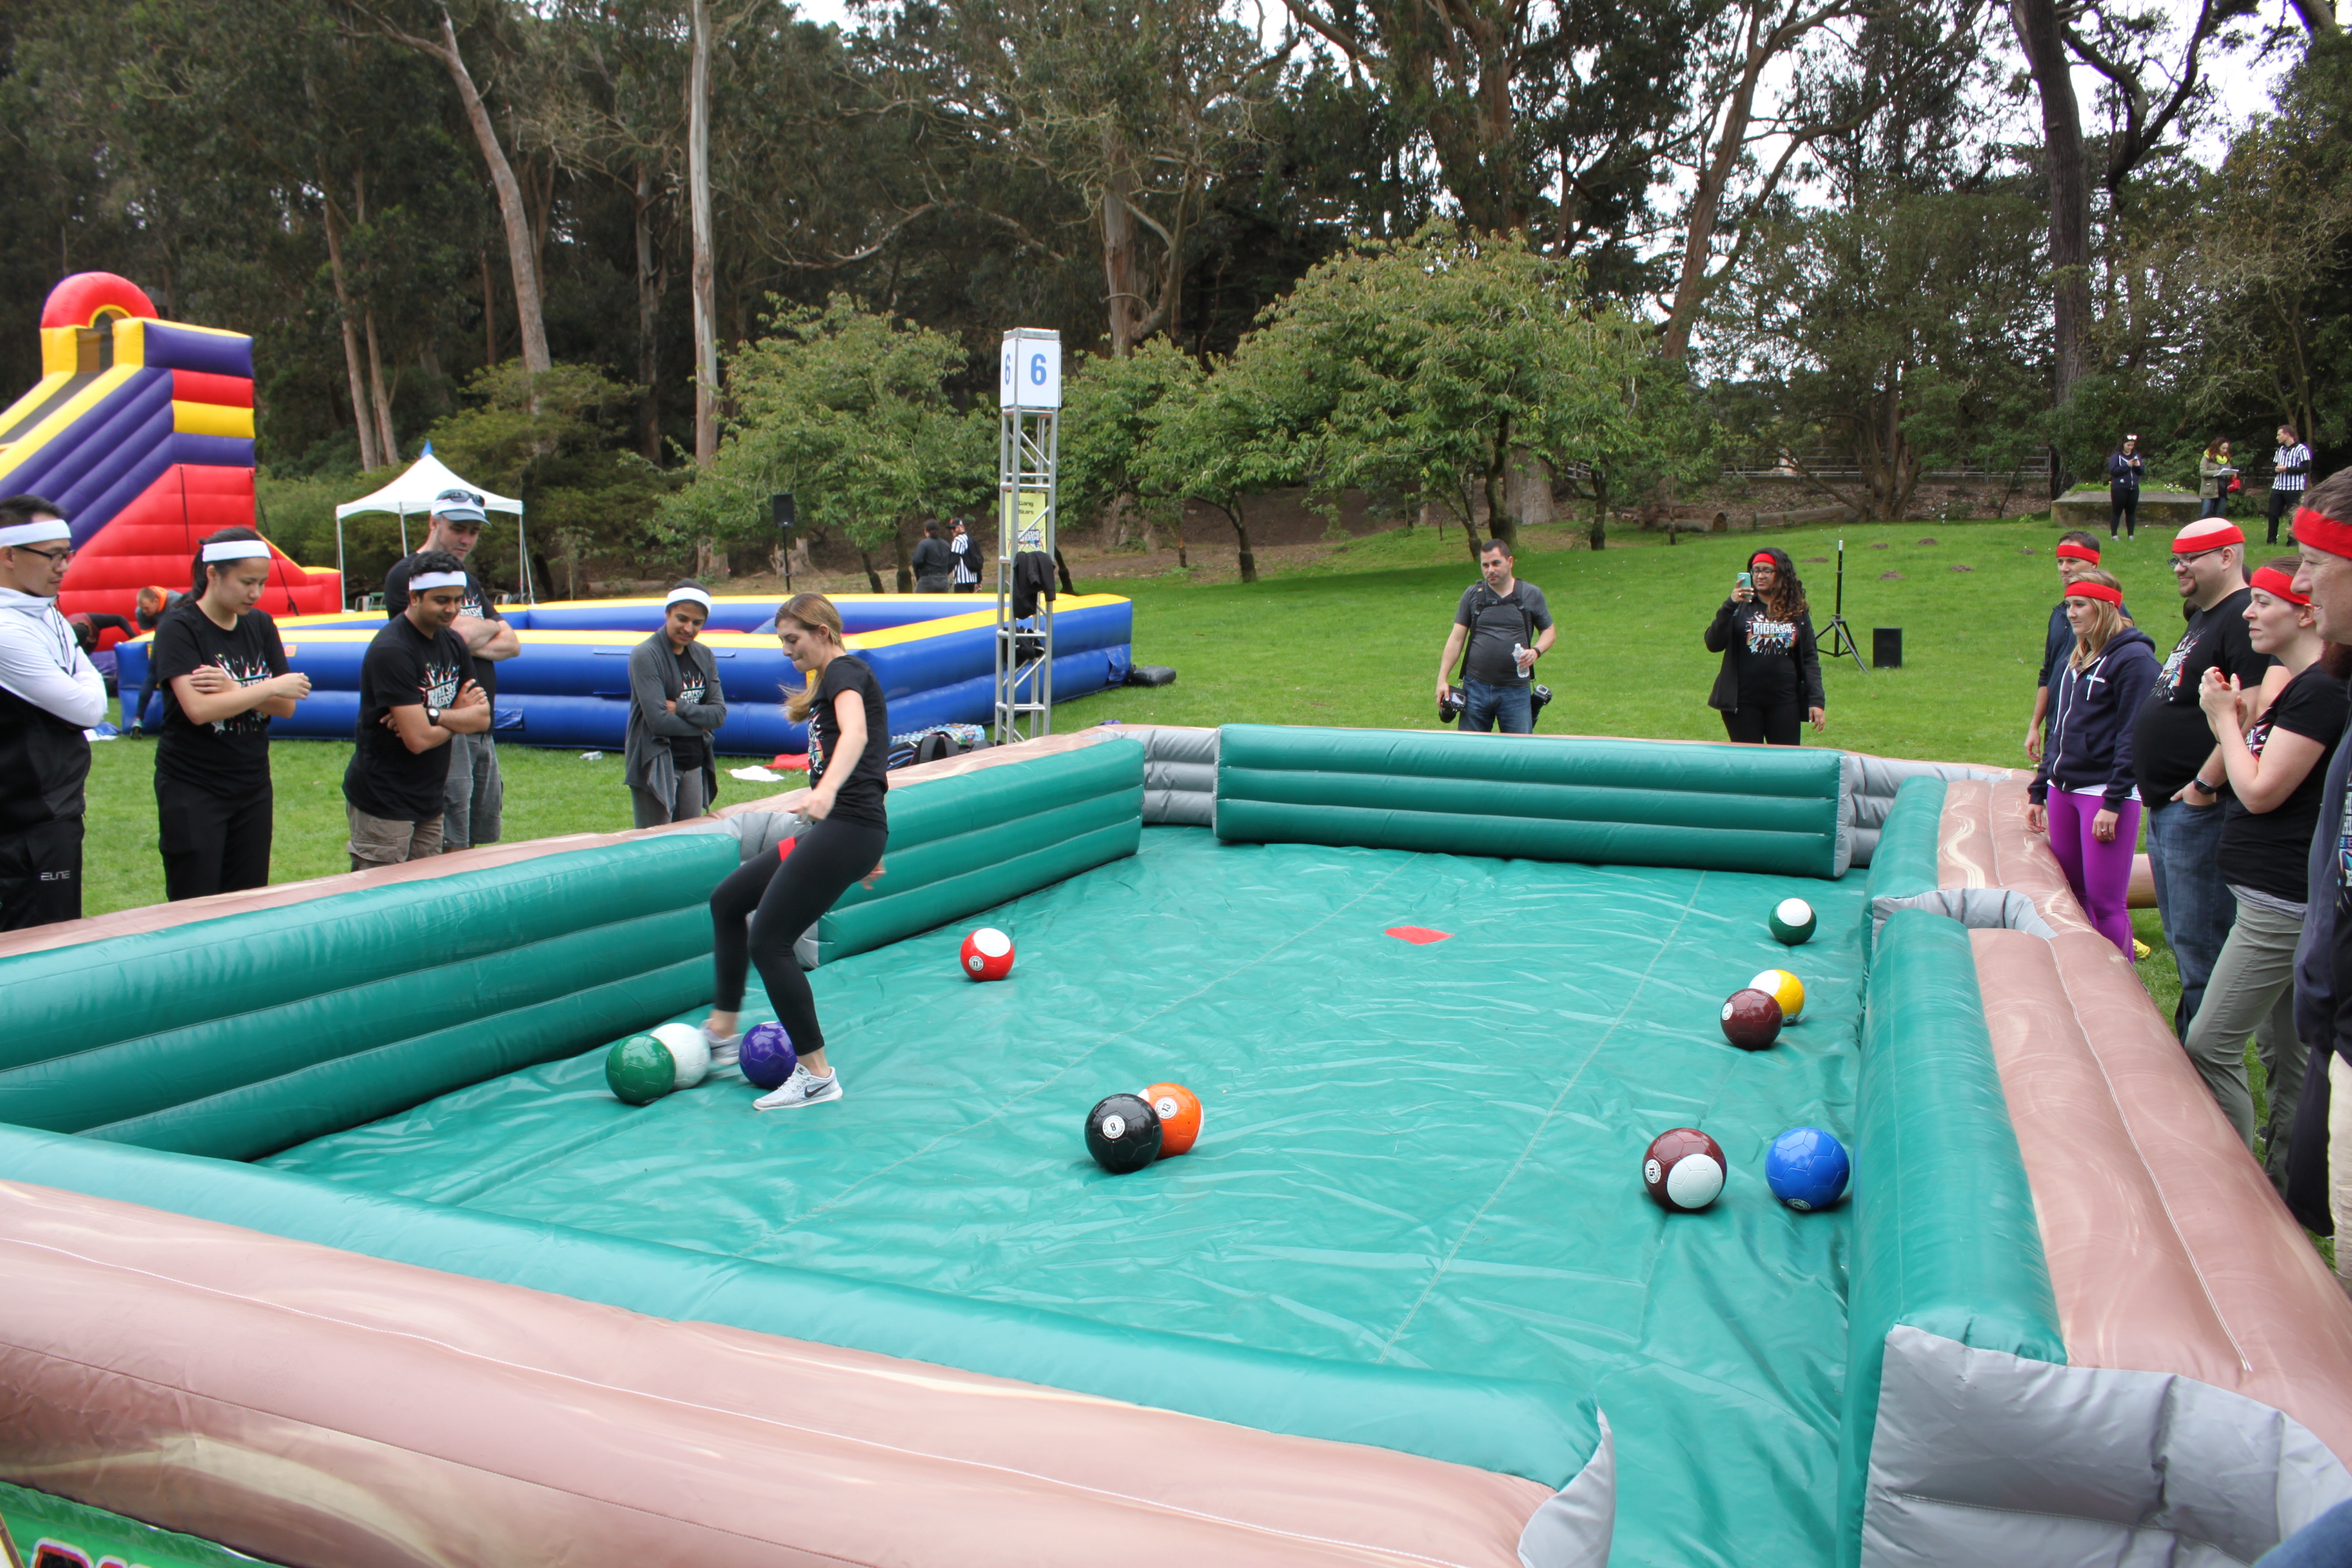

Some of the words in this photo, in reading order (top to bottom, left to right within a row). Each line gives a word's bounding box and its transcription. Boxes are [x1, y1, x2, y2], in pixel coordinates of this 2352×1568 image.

[1005, 353, 1011, 385] 6
[1030, 353, 1047, 386] 6
[1161, 1102, 1171, 1112] 13
[1110, 1122, 1117, 1131] 8
[1648, 1166, 1656, 1177] 15
